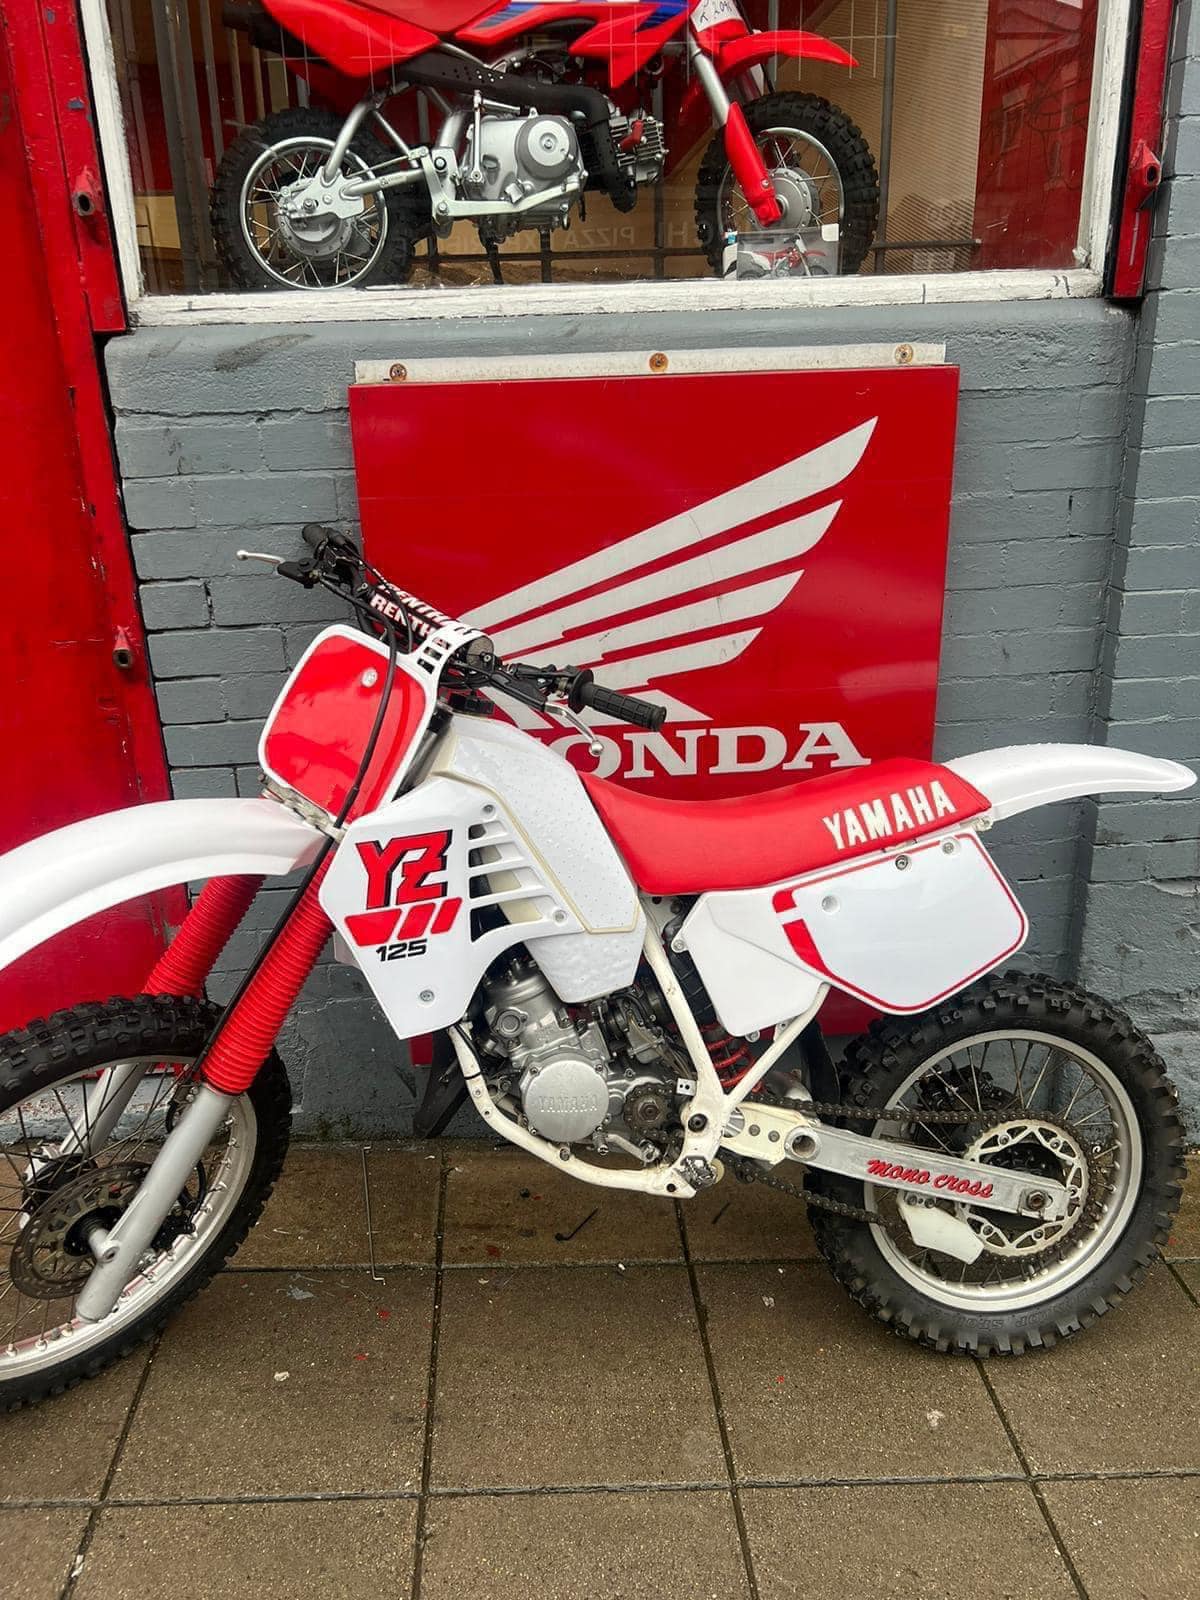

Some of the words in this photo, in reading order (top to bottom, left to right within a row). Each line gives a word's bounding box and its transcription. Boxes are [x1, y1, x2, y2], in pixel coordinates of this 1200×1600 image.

[546, 721, 872, 779] ONDA
[822, 780, 957, 850] YAMAHA
[355, 829, 453, 910] YZ
[375, 938, 428, 962] 125
[933, 1174, 994, 1198] cross
